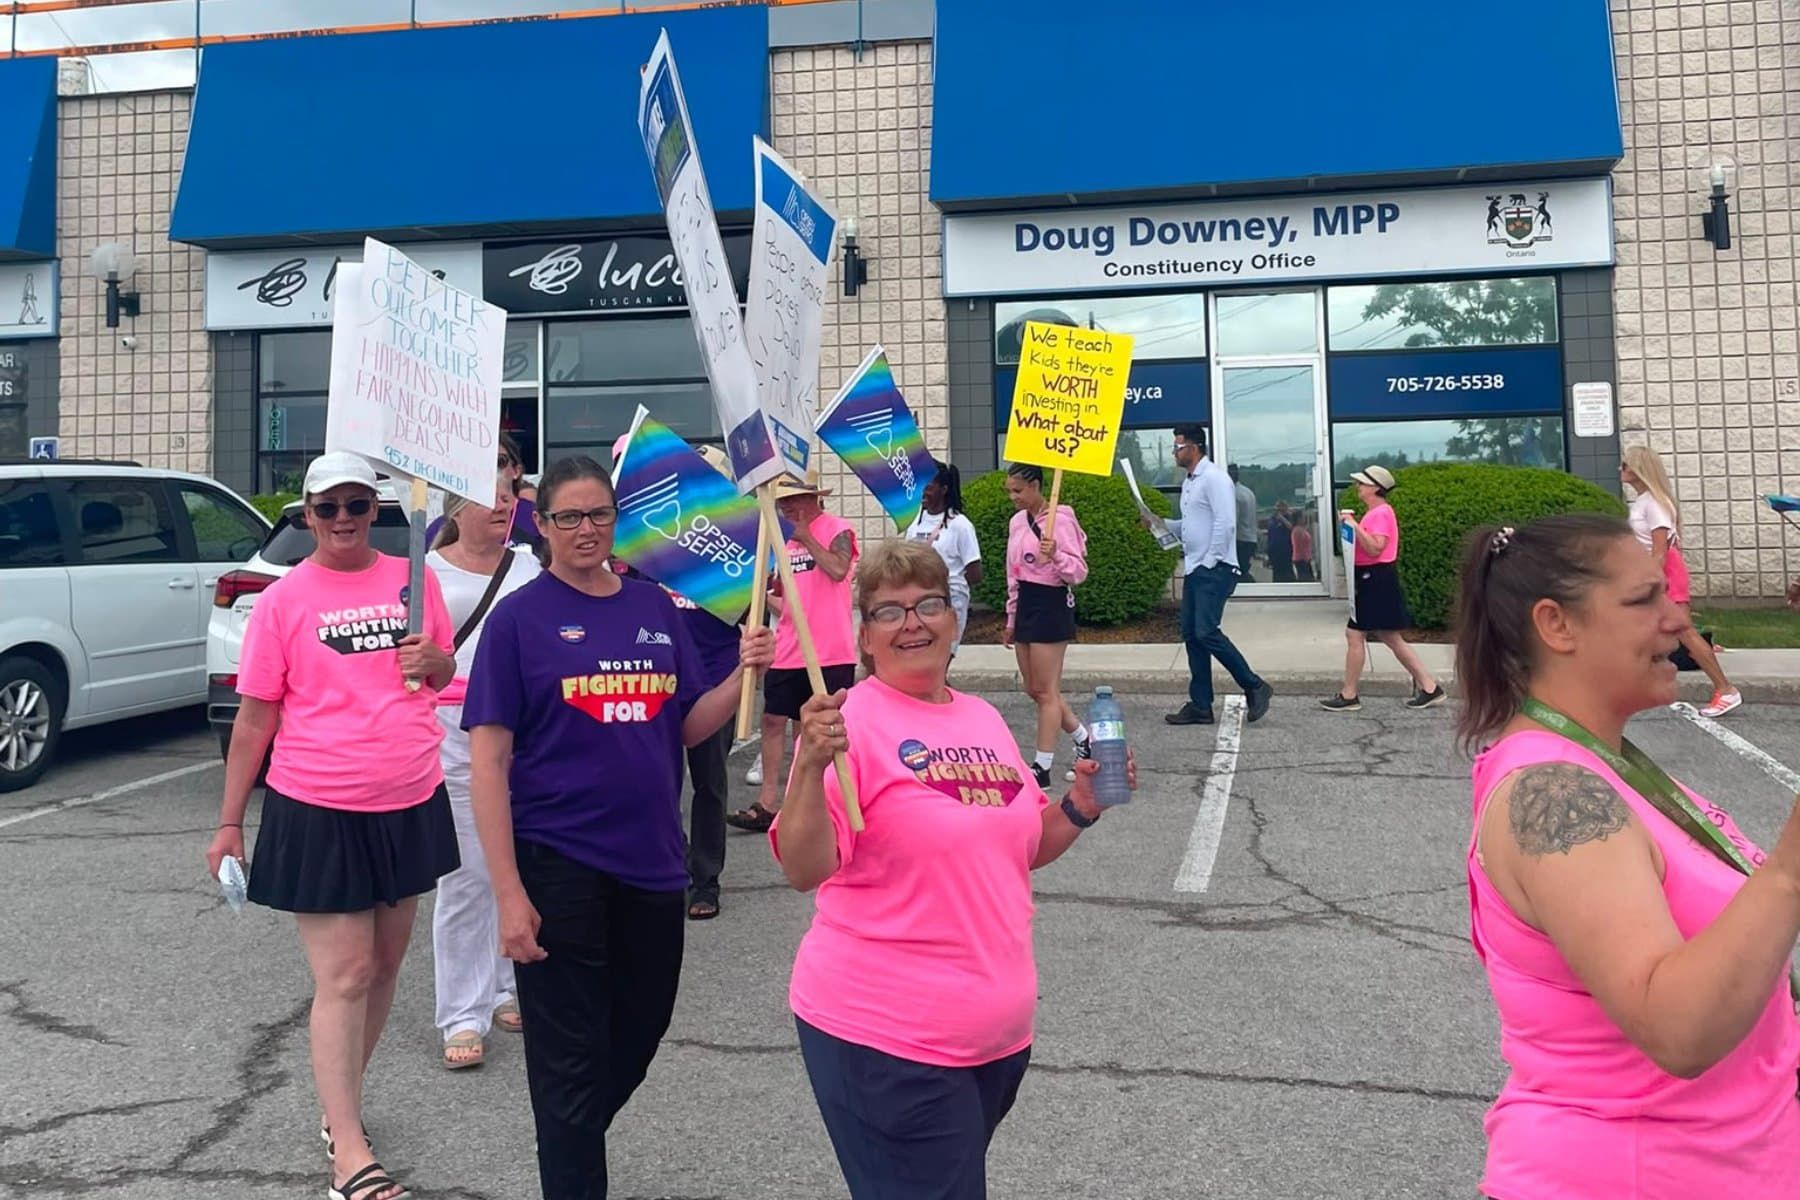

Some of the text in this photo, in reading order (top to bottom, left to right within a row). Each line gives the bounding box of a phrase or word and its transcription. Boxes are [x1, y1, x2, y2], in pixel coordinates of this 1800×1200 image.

[1015, 203, 1400, 256] Doug Downey, MPP
[1104, 253, 1316, 277] Constituency Office
[1505, 250, 1536, 258] Ontario
[388, 248, 488, 329] BETTER
[589, 295, 653, 307] TUSCAN
[1030, 326, 1112, 353] We teach
[1066, 356, 1114, 377] they're
[1042, 373, 1099, 399] WORTH
[1386, 374, 1505, 393] 705-726-5538
[444, 374, 487, 418] WITH
[1022, 389, 1081, 418] investing
[270, 409, 281, 449] OPEN
[1015, 409, 1108, 442] What about
[1044, 437, 1080, 458] us?
[691, 514, 756, 566] OPSEU
[677, 530, 743, 577] SEFPO
[319, 604, 405, 624] WORTH
[351, 633, 395, 651] FOR
[598, 660, 653, 671] WORTH
[561, 673, 677, 700] FIGHTING
[603, 701, 648, 723] FOR
[929, 747, 999, 763] WORTH
[958, 785, 1007, 807] FOR
